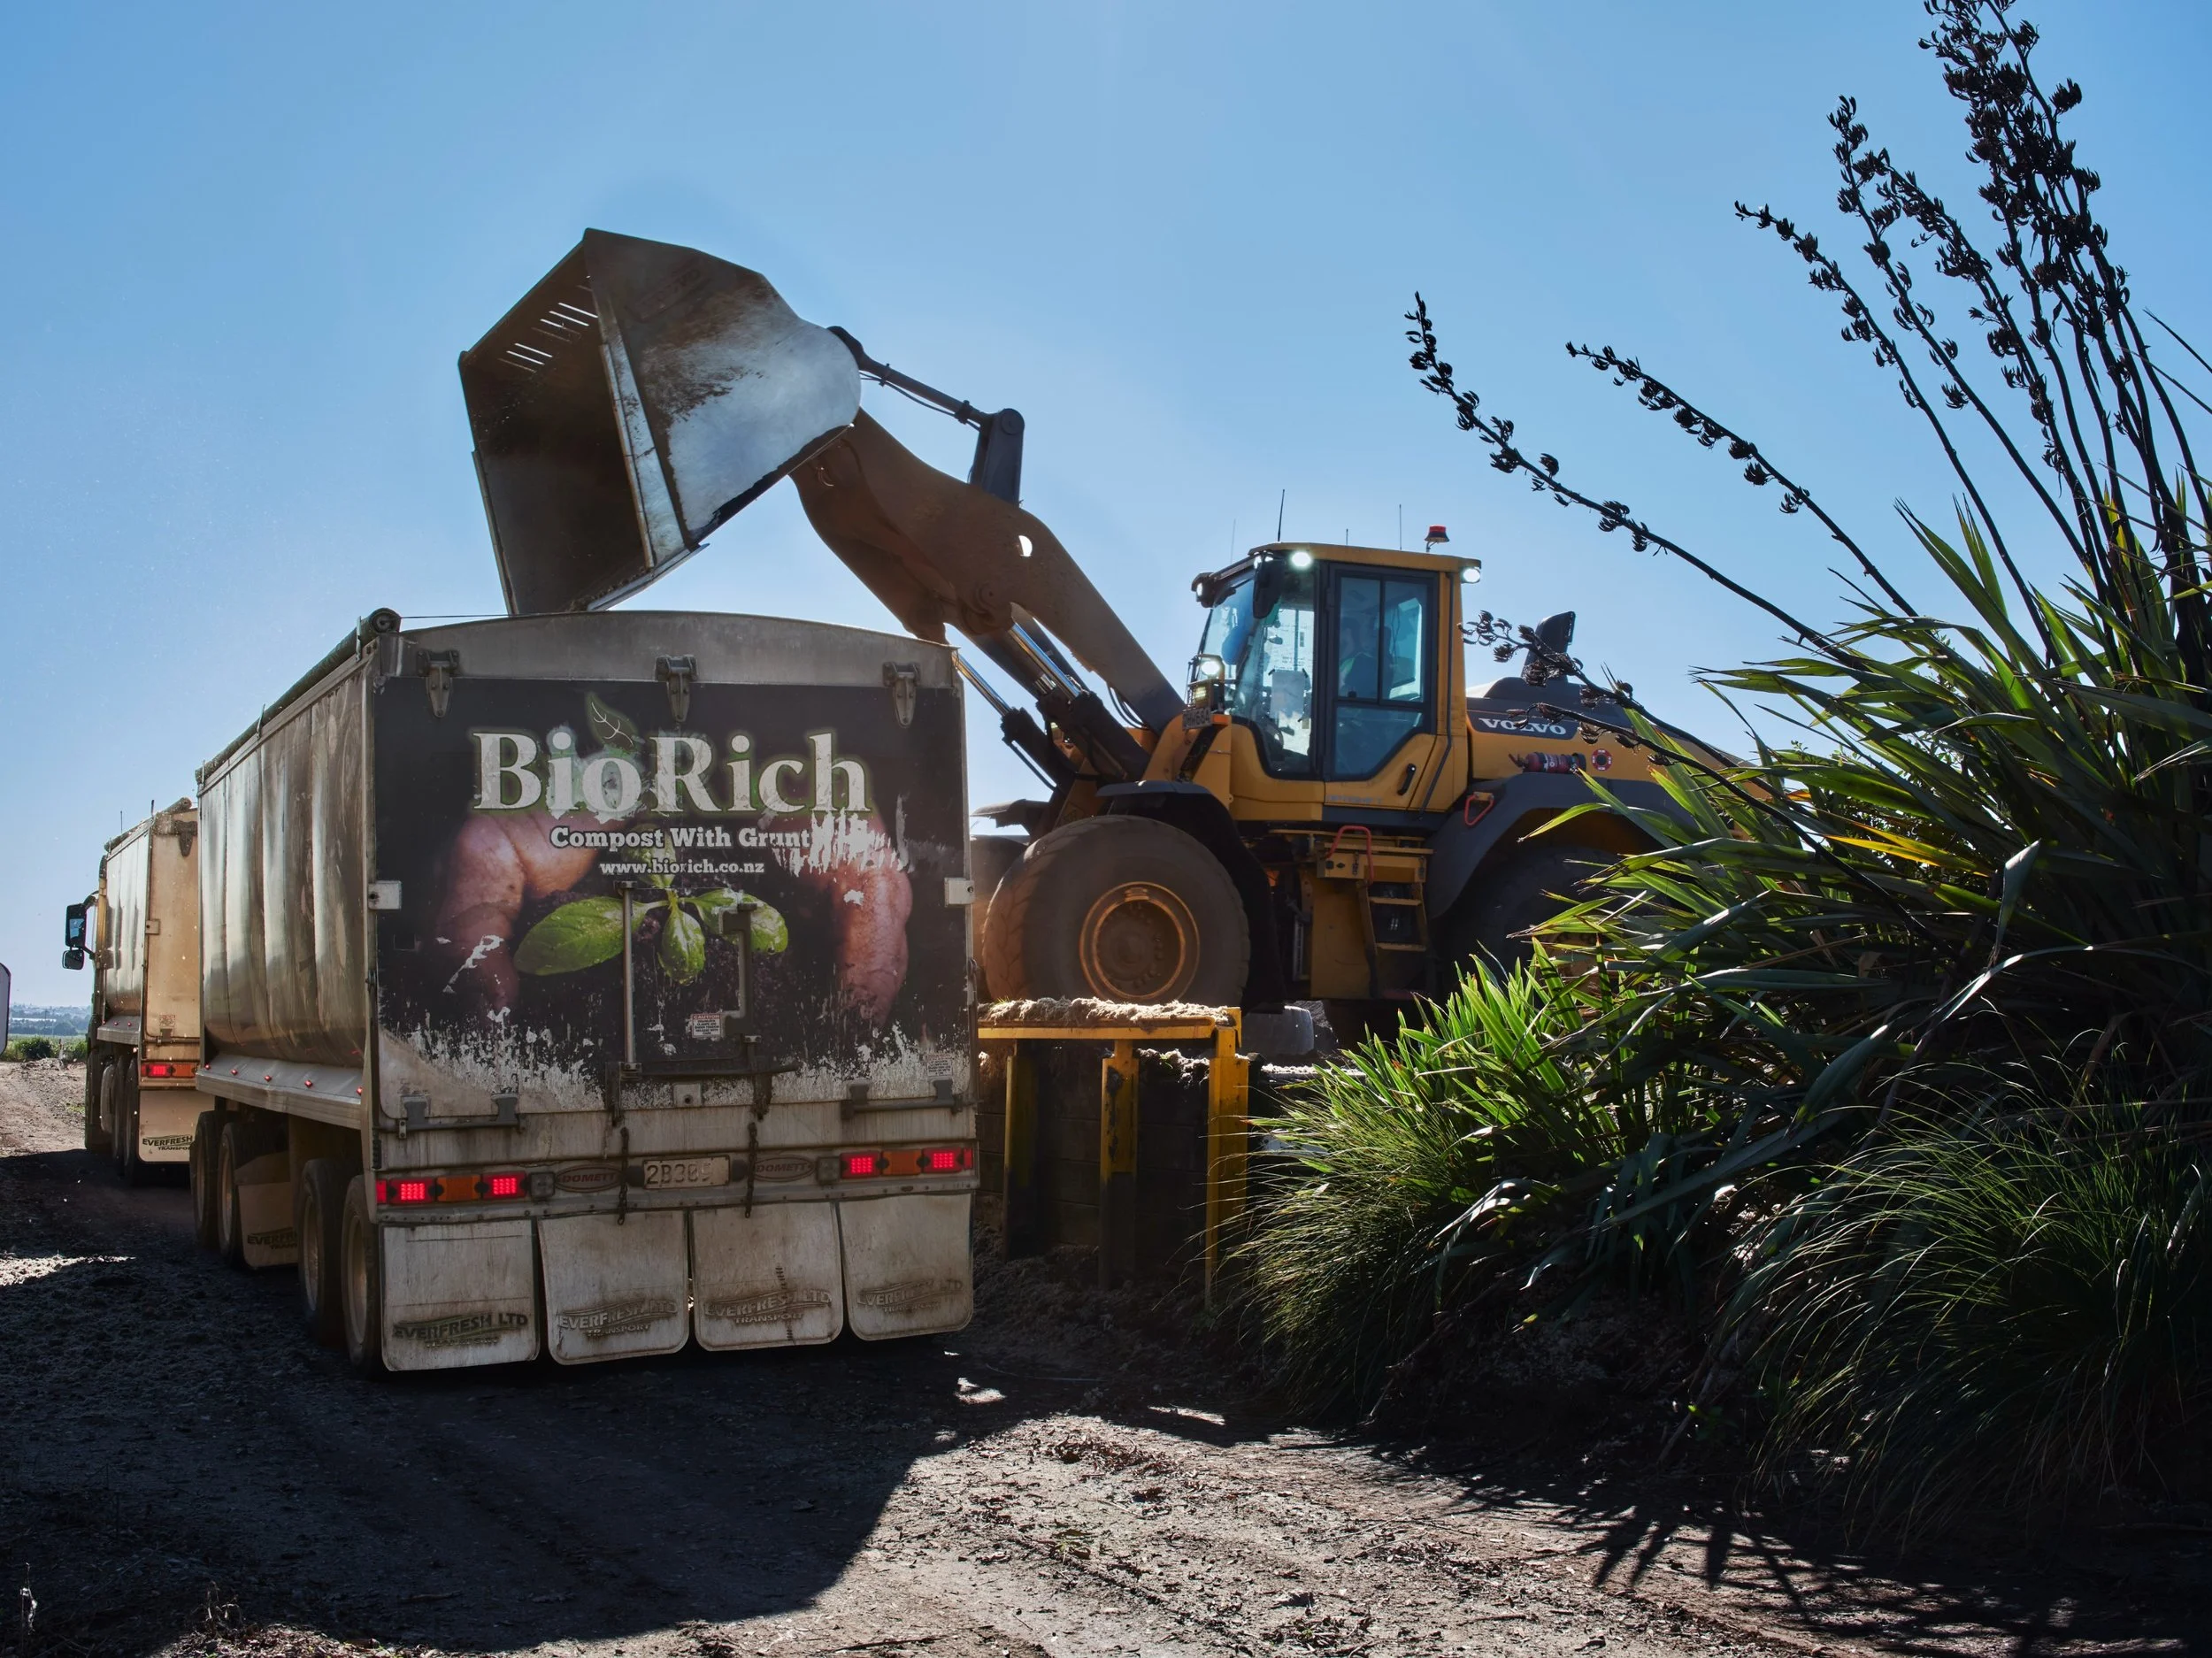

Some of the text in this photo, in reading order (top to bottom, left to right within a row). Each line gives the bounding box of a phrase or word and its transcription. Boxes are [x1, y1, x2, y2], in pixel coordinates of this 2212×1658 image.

[1479, 718, 1567, 735] VOLVO
[473, 731, 870, 814] BioRich
[549, 826, 810, 851] Compost With Grunt
[599, 858, 764, 874] www.biorich.co.nz
[142, 1136, 193, 1146] EVERFRESH
[757, 1163, 807, 1172] DOMETT
[562, 1172, 618, 1183] DOMETT
[803, 1289, 832, 1304] LTD
[650, 1300, 679, 1314] LTD
[393, 1313, 528, 1339] EVERFRESH LTD
